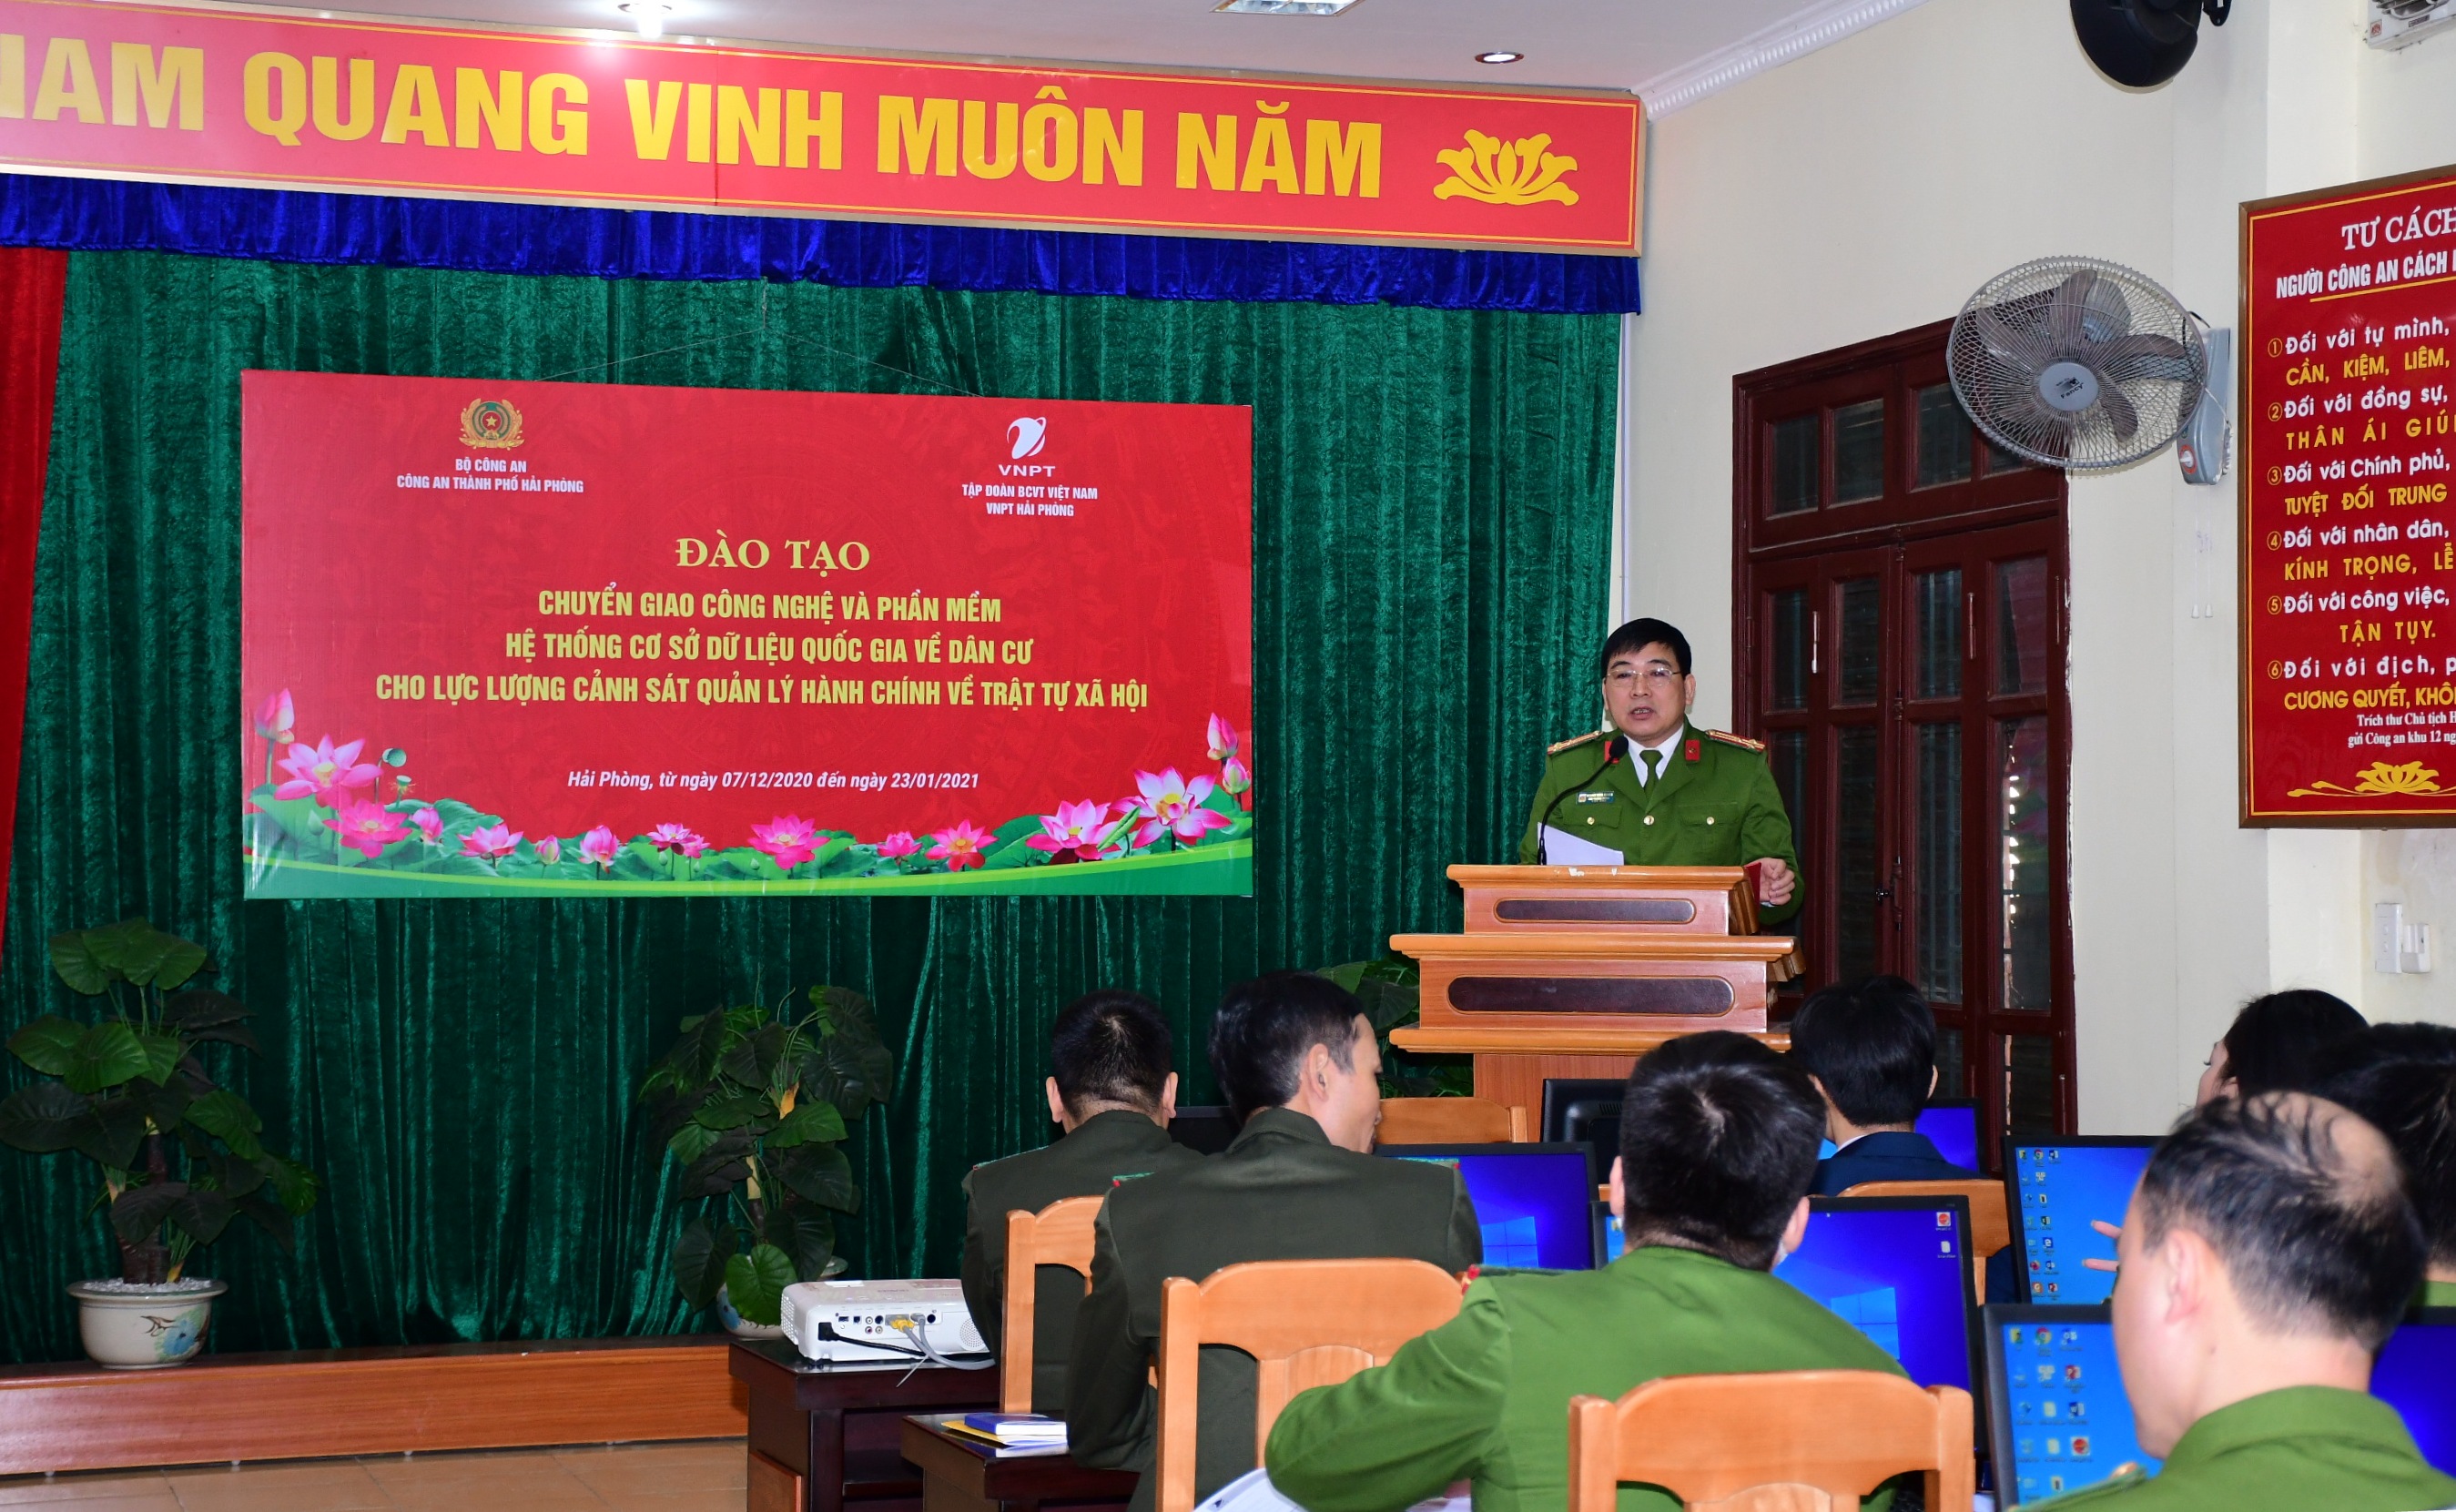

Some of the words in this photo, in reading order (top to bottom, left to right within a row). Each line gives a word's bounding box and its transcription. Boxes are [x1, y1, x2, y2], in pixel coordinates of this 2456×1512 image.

[243, 51, 588, 157] QUANG
[624, 79, 843, 169] VINH
[878, 86, 1144, 187] MUÔN
[1175, 99, 1382, 198] NĂM
[2342, 216, 2380, 250] TƯ
[2277, 268, 2323, 299] NGƯỜI
[2328, 264, 2370, 291] CÔNG
[2376, 259, 2398, 284] AN
[2403, 250, 2447, 279] CÁCH
[2286, 330, 2316, 354] Đối
[2327, 329, 2355, 349] với
[2365, 327, 2384, 347] tự
[2395, 317, 2449, 340] mình,
[2287, 358, 2329, 385] CẦN,
[2344, 354, 2389, 381] KIỆM,
[2405, 346, 2449, 370] LIÊM,
[2060, 382, 2084, 399] Fancy
[2284, 395, 2314, 418] Đối
[2324, 393, 2351, 413] với
[2361, 386, 2410, 410] đồng
[2420, 385, 2447, 405] sự,
[2287, 425, 2343, 450] THÂN
[2363, 418, 2385, 441] ÁI
[2406, 410, 2456, 437] GIÚ
[455, 457, 472, 473] BỘ
[474, 457, 506, 472] CÔNG
[510, 461, 526, 472] AN
[999, 464, 1055, 477] VNPT
[2284, 461, 2311, 482] Đối
[2319, 461, 2345, 480] với
[2351, 456, 2401, 477] Chính
[2410, 448, 2450, 475] phủ,
[397, 473, 430, 488] CÔNG
[432, 476, 450, 489] AN
[452, 475, 492, 490] THÀNH
[495, 474, 518, 491] PHỐ
[522, 475, 541, 492] HẢI
[544, 477, 584, 492] PHÒNG
[962, 482, 982, 498] TẬP
[985, 483, 1015, 497] ĐOÀN
[1018, 486, 1045, 498] BCVT
[1048, 484, 1070, 501] VIỆT
[1072, 487, 1098, 499] NAM
[986, 502, 1014, 514] VNPT
[1017, 500, 1034, 515] HẢI
[1038, 502, 1074, 516] PHÒNG
[2285, 491, 2328, 517] TUYỆT
[2342, 483, 2373, 510] ĐỐI
[2389, 483, 2447, 505] TRUNG
[2283, 526, 2311, 548] Đối
[2320, 526, 2346, 545] với
[2354, 523, 2398, 543] nhân
[2407, 519, 2449, 539] dân,
[675, 530, 769, 568] ĐÀO
[785, 540, 869, 577] TẠO
[2285, 556, 2328, 580] KÍNH
[2344, 554, 2416, 580] TRỌNG,
[2435, 543, 2453, 570] LỄ
[539, 582, 632, 615] CHUYỂN
[641, 593, 694, 617] GIAO
[703, 589, 765, 618] CÔNG
[774, 591, 833, 624] NGHỆ
[841, 592, 869, 620] VÀ
[878, 590, 939, 621] PHẦN
[947, 591, 1000, 622] MỀM
[2284, 592, 2312, 613] Đối
[2319, 592, 2345, 611] với
[2350, 590, 2398, 611] công
[2404, 586, 2449, 609] việc,
[507, 628, 535, 663] HỆ
[543, 626, 621, 658] THỐNG
[630, 634, 661, 659] CƠ
[669, 628, 699, 659] SỞ
[707, 632, 740, 660] DỮ
[746, 633, 794, 665] LIỆU
[802, 630, 861, 664] QUỐC
[870, 639, 907, 662] GIA
[915, 632, 940, 663] VỀ
[949, 635, 994, 663] DÂN
[1002, 639, 1033, 664] CƯ
[2340, 620, 2380, 646] TẬN
[2395, 621, 2435, 644] TỤY.
[2284, 657, 2319, 678] Đối
[2331, 657, 2365, 676] với
[2377, 655, 2434, 677] địch,
[377, 675, 424, 699] CHO
[434, 674, 478, 705] LỰC
[487, 675, 564, 705] LƯỢNG
[573, 669, 637, 701] CẢNH
[646, 674, 689, 702] SÁT
[697, 671, 760, 705] QUẢN
[768, 675, 793, 703] LÝ
[802, 675, 863, 704] HÀNH
[872, 676, 939, 705] CHÍNH
[948, 675, 973, 705] VỀ
[981, 677, 1034, 710] TRẬT
[1041, 681, 1070, 711] TỰ
[1075, 679, 1104, 706] XÃ
[1111, 679, 1147, 712] HỘI
[2285, 691, 2349, 710] CƯƠNG
[2353, 682, 2410, 708] QUYẾT,
[2416, 682, 2456, 705] KHÔ
[2357, 715, 2383, 726] Trích
[2386, 714, 2402, 726] thư
[2405, 712, 2425, 725] Chủ
[2428, 712, 2446, 724] tịch
[2365, 733, 2391, 746] Công
[2393, 735, 2405, 743] an
[2408, 731, 2427, 743] khu
[2430, 729, 2442, 743] 12
[568, 769, 595, 786] Hải
[599, 771, 653, 790] Phòng,
[659, 771, 677, 786] từ
[680, 771, 718, 791] ngày
[722, 772, 813, 788] 07/12/2020
[817, 771, 846, 787] đến
[850, 772, 888, 791] ngày
[891, 773, 978, 788] 23/01/2021
